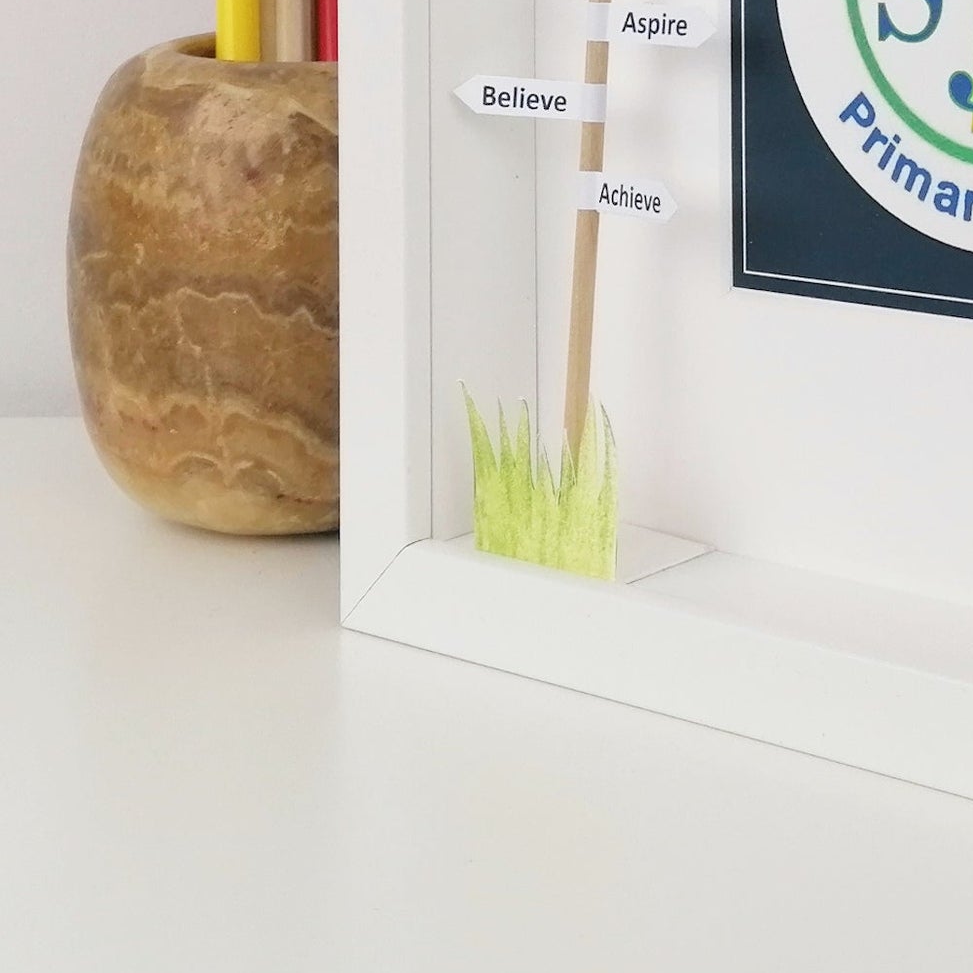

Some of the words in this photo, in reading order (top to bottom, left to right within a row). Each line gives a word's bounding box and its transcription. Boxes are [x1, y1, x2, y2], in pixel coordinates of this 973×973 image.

[621, 11, 688, 40] Aspire
[481, 85, 567, 112] Believe
[598, 182, 662, 214] Achieve
